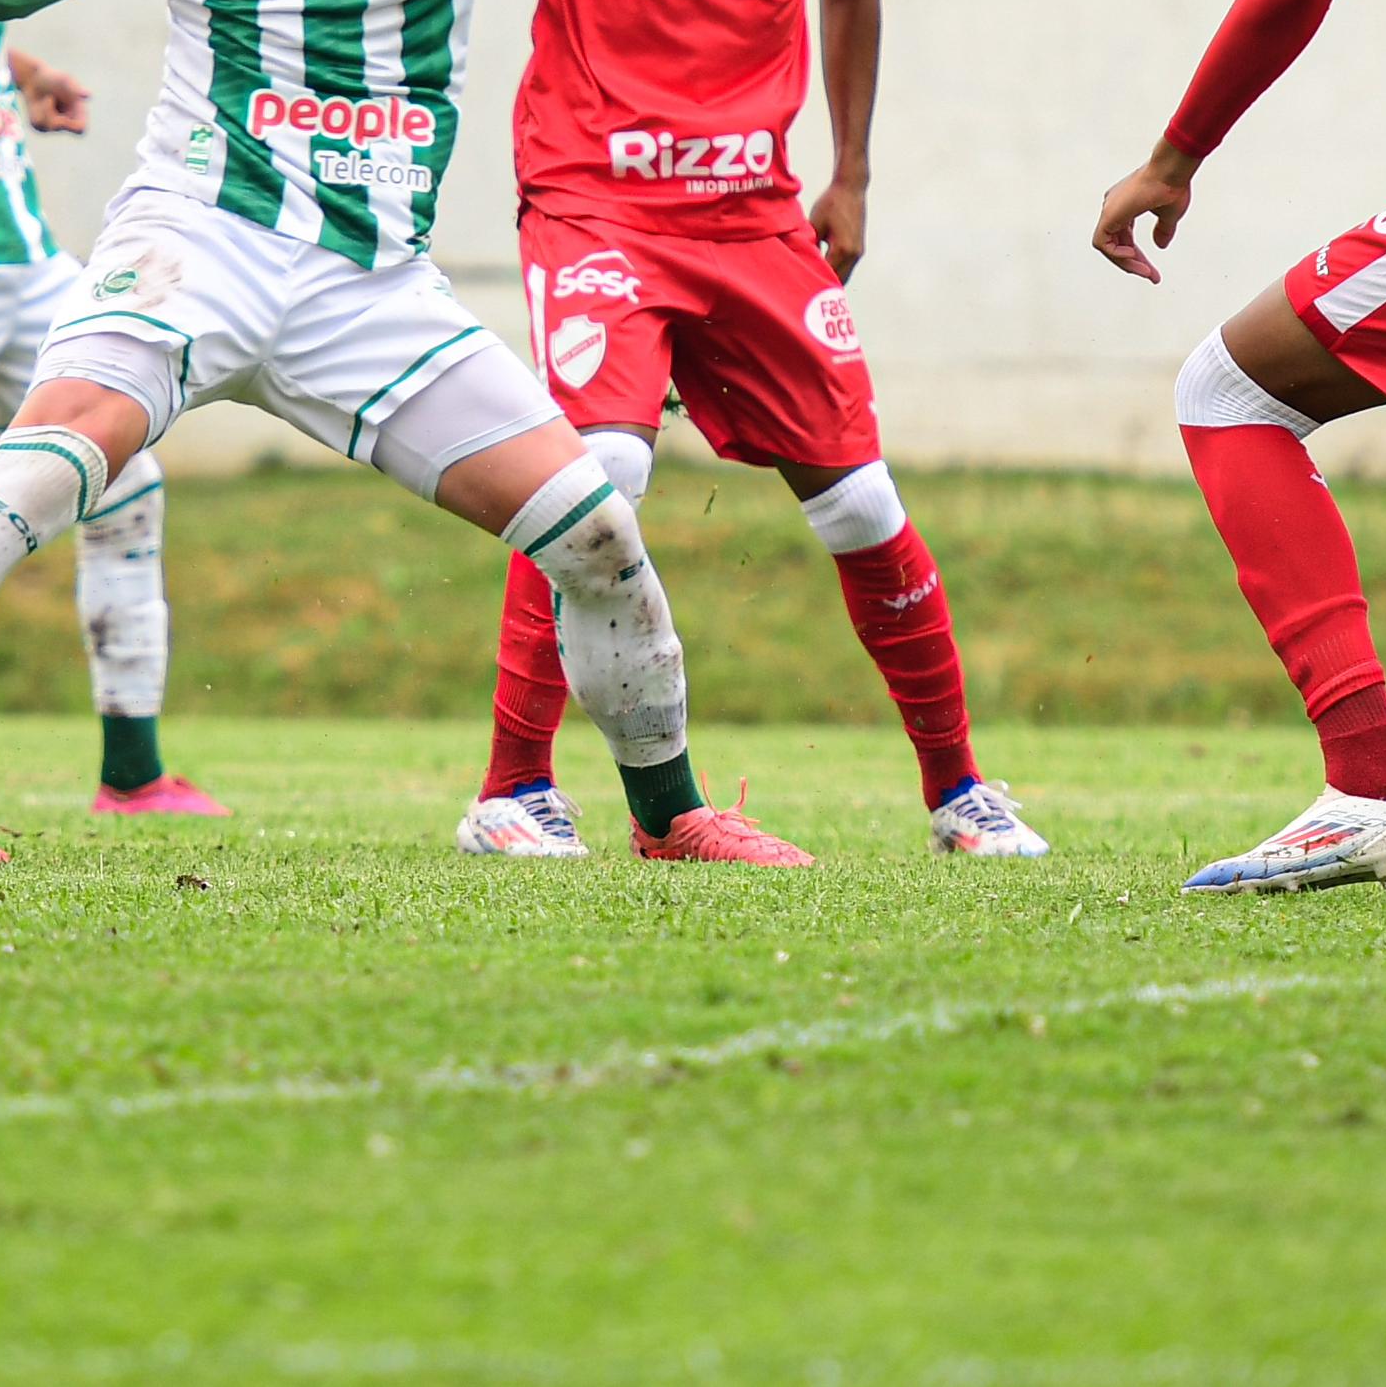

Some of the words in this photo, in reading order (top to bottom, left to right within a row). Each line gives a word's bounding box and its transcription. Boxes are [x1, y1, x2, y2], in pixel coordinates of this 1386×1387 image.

[252, 92, 431, 146] people
[319, 154, 430, 189] Telecom
[609, 129, 774, 181] Rizzo
